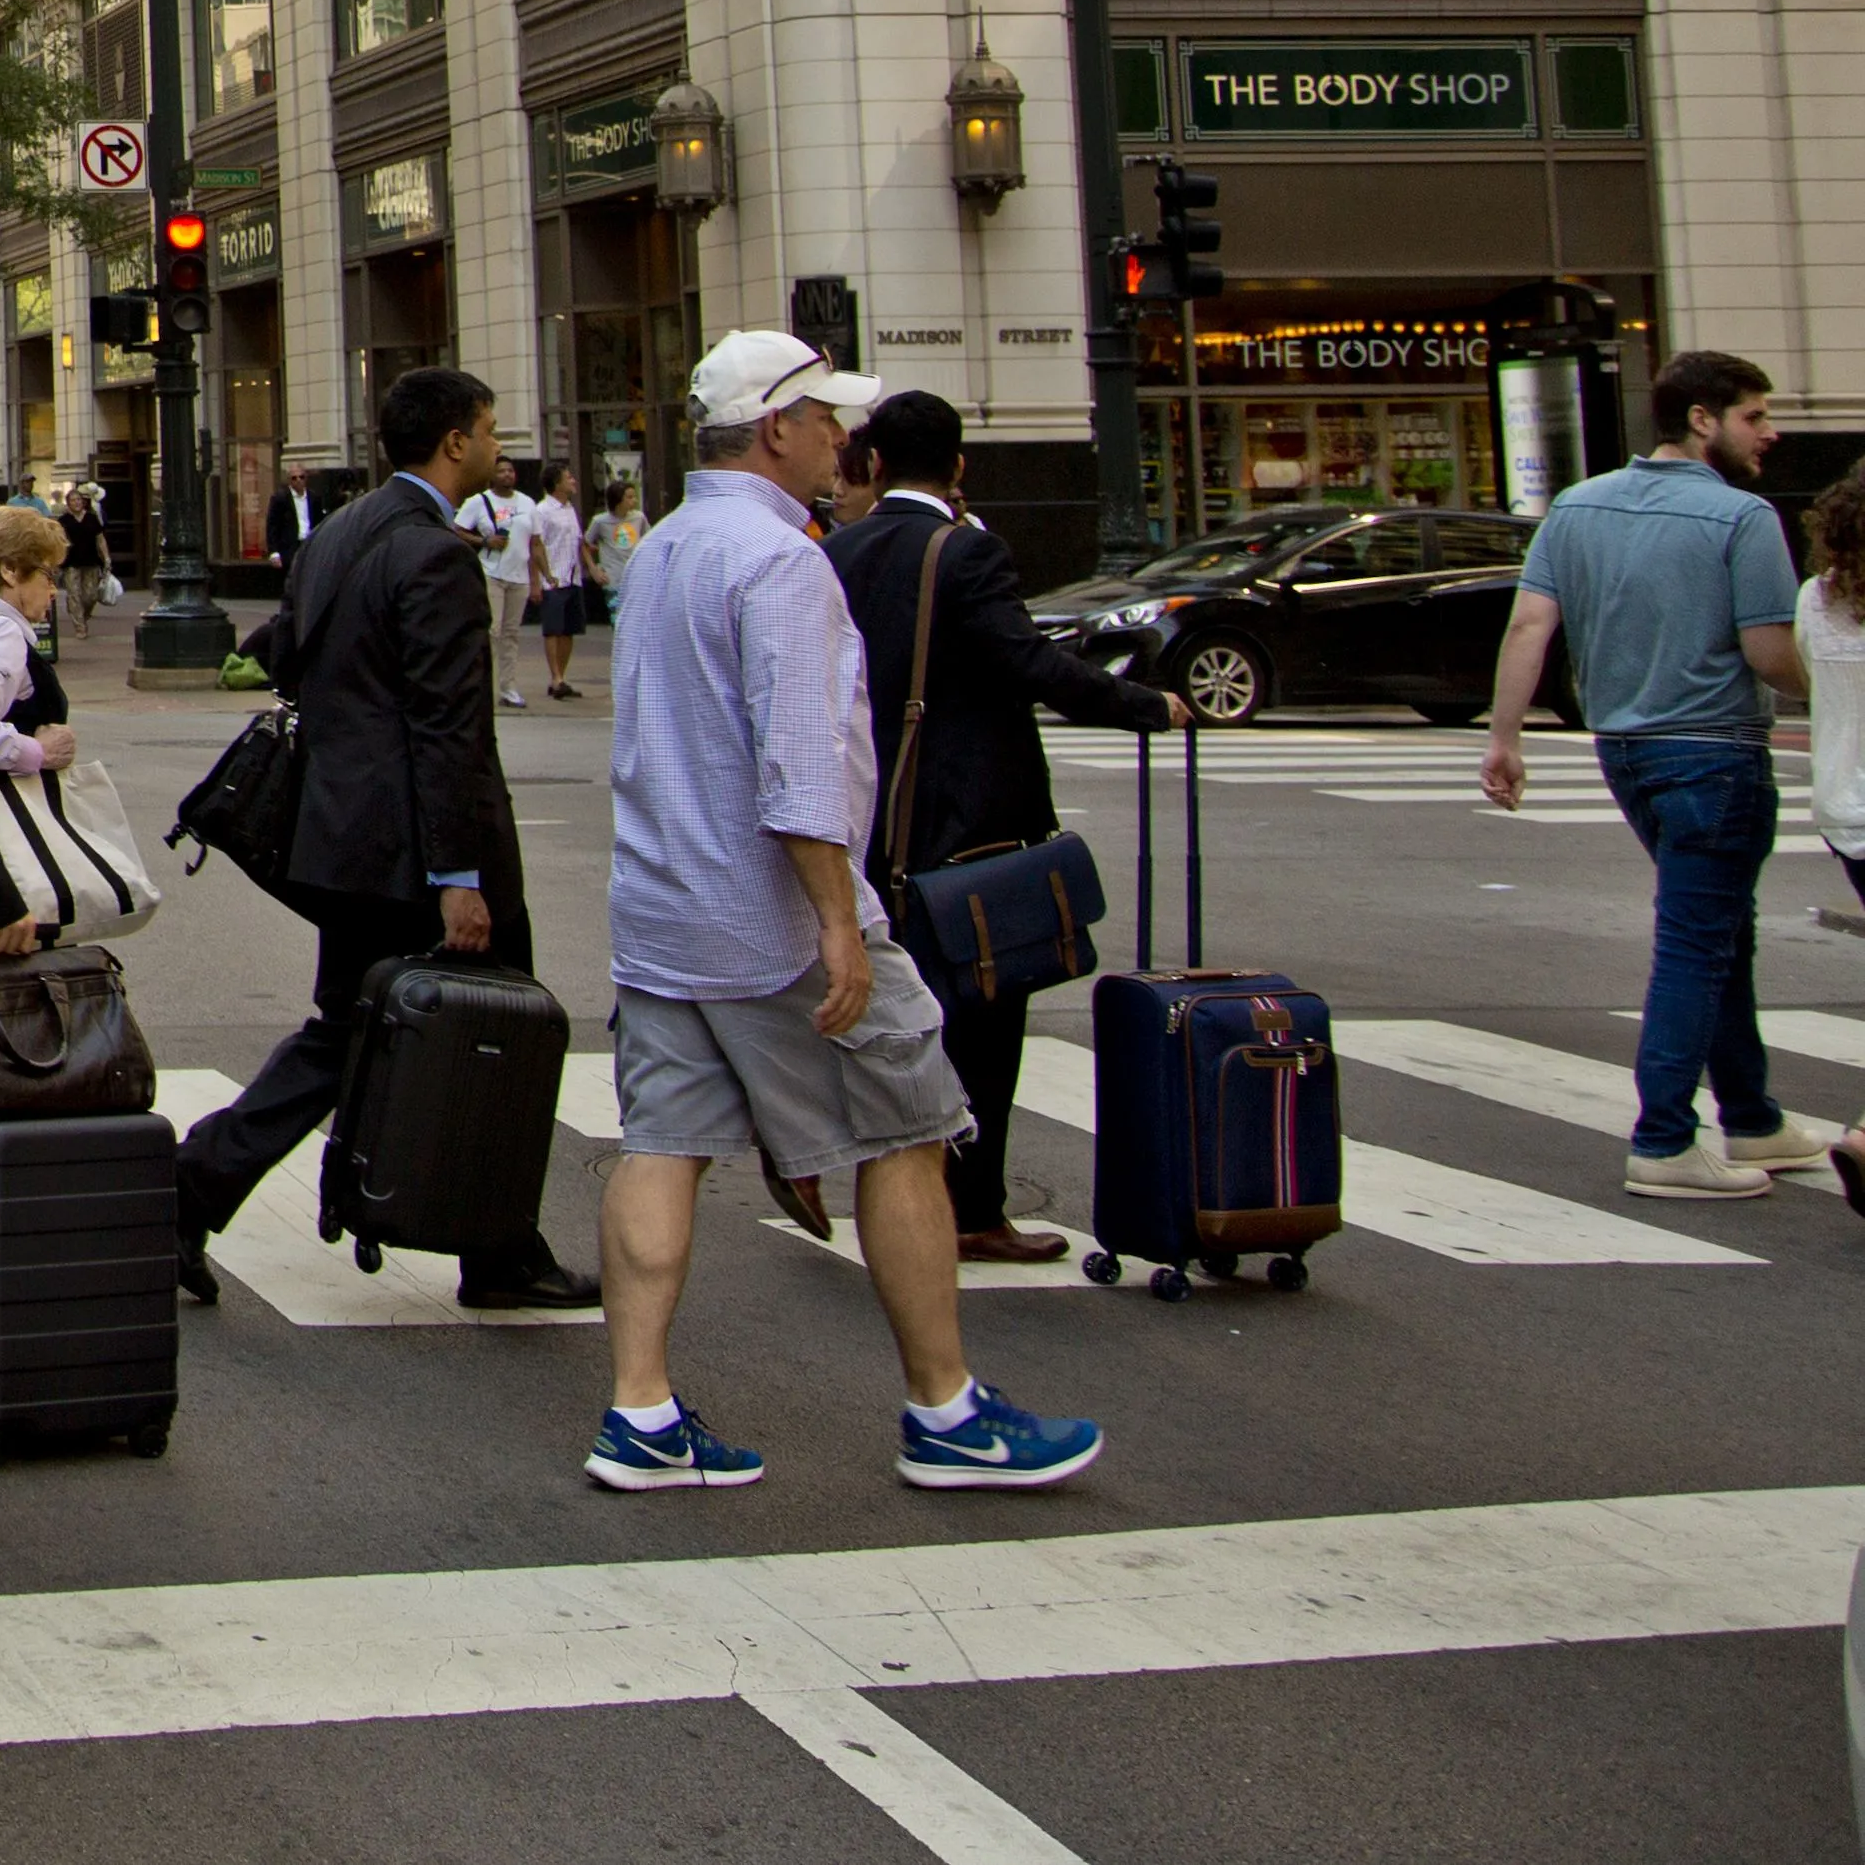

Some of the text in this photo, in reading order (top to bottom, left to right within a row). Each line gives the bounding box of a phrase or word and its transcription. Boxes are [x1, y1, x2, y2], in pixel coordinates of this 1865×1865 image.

[1205, 73, 1511, 106] THE BODY SHOP
[595, 121, 631, 157] BODY
[195, 172, 241, 184] MADISON
[220, 222, 274, 266] TORRID
[800, 284, 844, 325] ONE
[876, 328, 1073, 345] MADISON STREET
[1235, 338, 1490, 369] THE BODY SHO
